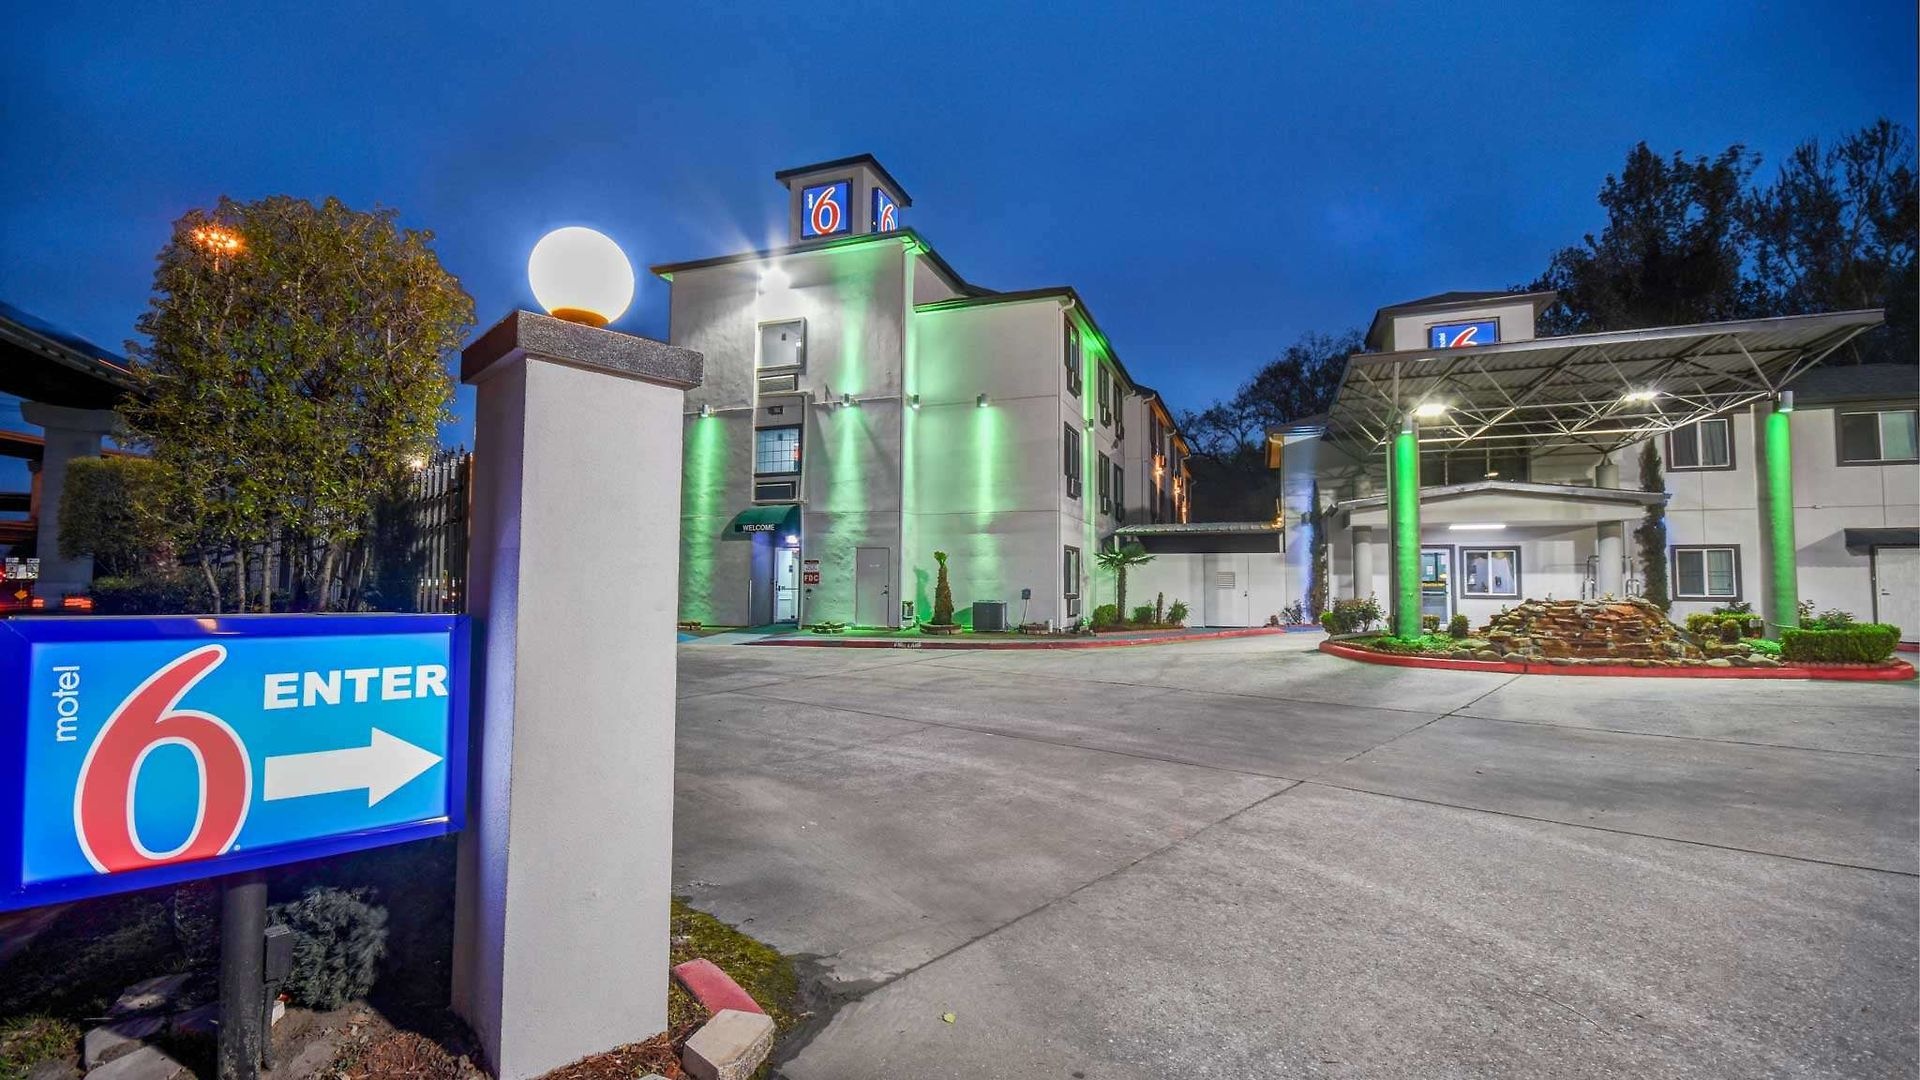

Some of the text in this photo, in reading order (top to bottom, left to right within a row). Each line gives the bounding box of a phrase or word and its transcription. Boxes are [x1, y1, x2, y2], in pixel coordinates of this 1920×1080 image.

[811, 186, 840, 235] 6
[804, 574, 819, 582] FDC
[53, 666, 80, 742] motel
[263, 664, 449, 710] ENTER
[74, 644, 253, 873] 6
